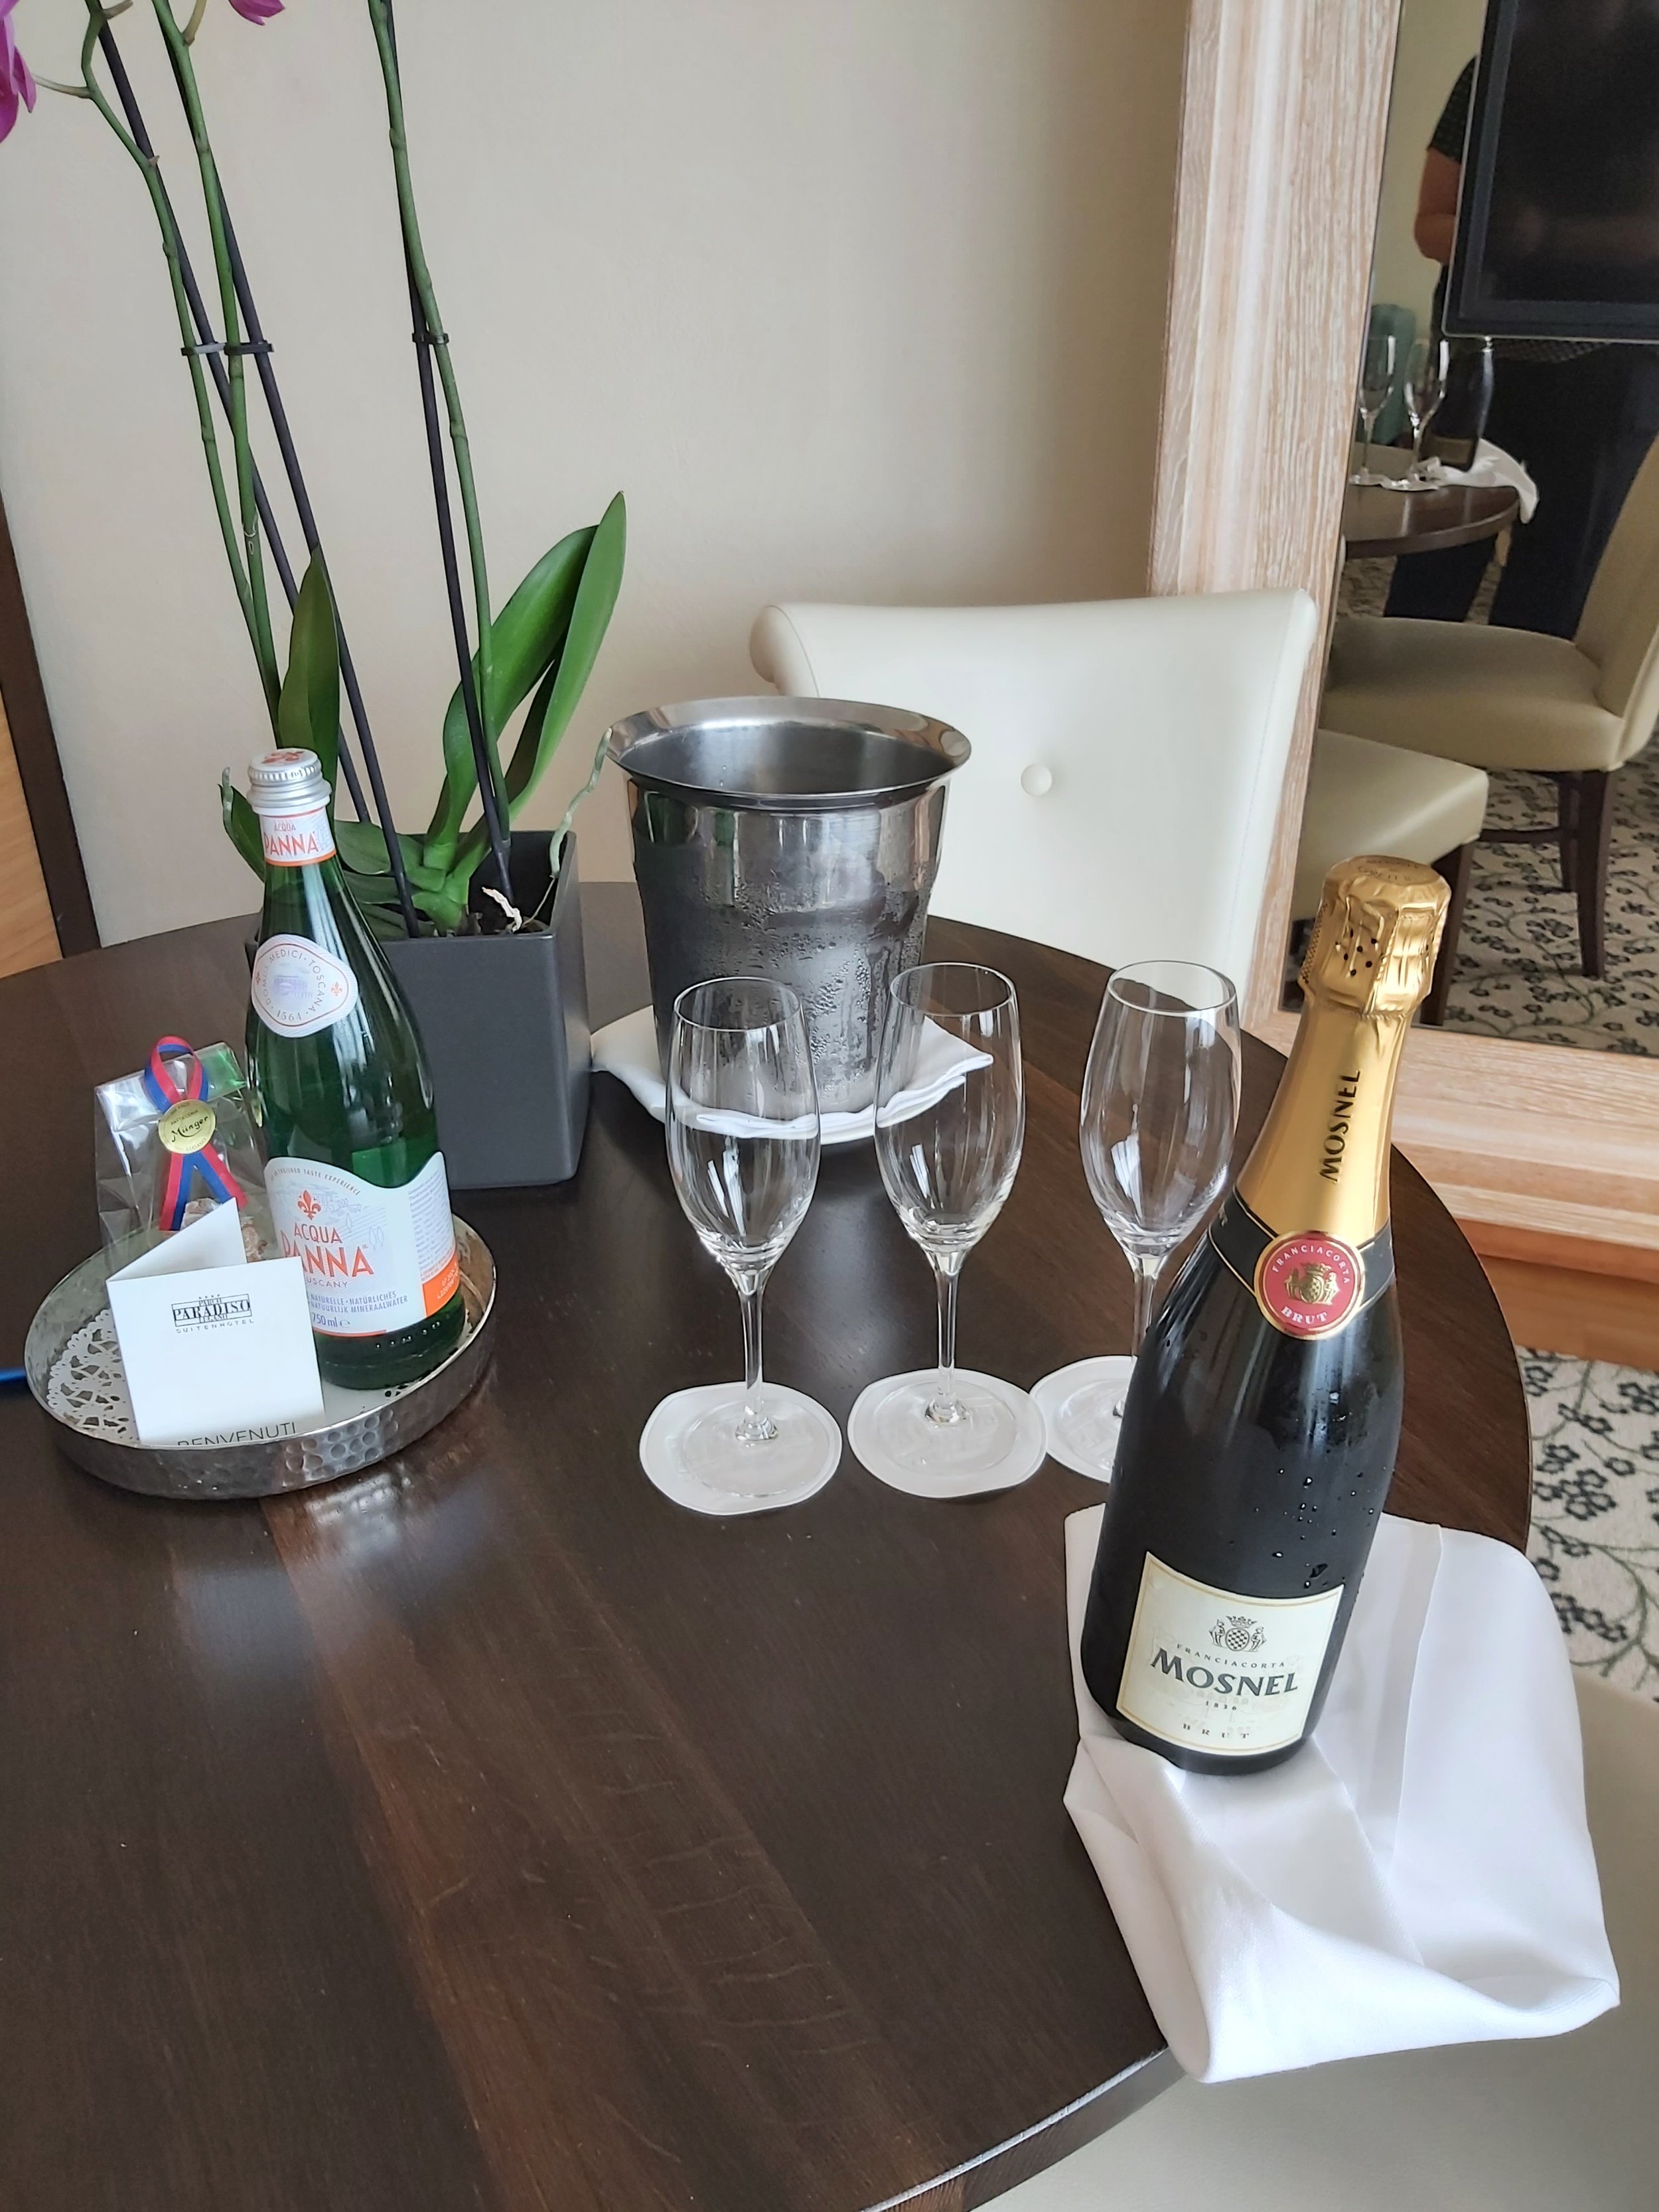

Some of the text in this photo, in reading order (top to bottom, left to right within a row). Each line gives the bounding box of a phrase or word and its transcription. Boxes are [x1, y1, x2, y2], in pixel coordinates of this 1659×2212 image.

[274, 823, 296, 832] ACQUA
[263, 832, 319, 855] PANNA
[269, 949, 303, 962] MEDICI
[308, 960, 326, 1012] TOSCANA
[1319, 1070, 1360, 1183] MOSNEL
[304, 1169, 321, 1178] TASTE
[325, 1174, 361, 1195] EXPERIENCE
[294, 1222, 342, 1243] ACQUA
[1272, 1245, 1351, 1284] FRANCIACORTA
[307, 1276, 348, 1288] USCANY
[173, 1299, 251, 1321] PARADISO
[311, 1295, 408, 1313] NATUURLIJK MINERAALWATER
[312, 1312, 338, 1327] 750 ml
[1281, 1307, 1327, 1324] BRUT
[1176, 1643, 1285, 1668] FRANCIACORTA
[1150, 1647, 1299, 1696] MOSNEL
[1205, 1700, 1237, 1710] 1836
[1183, 1723, 1250, 1739] BRUT
